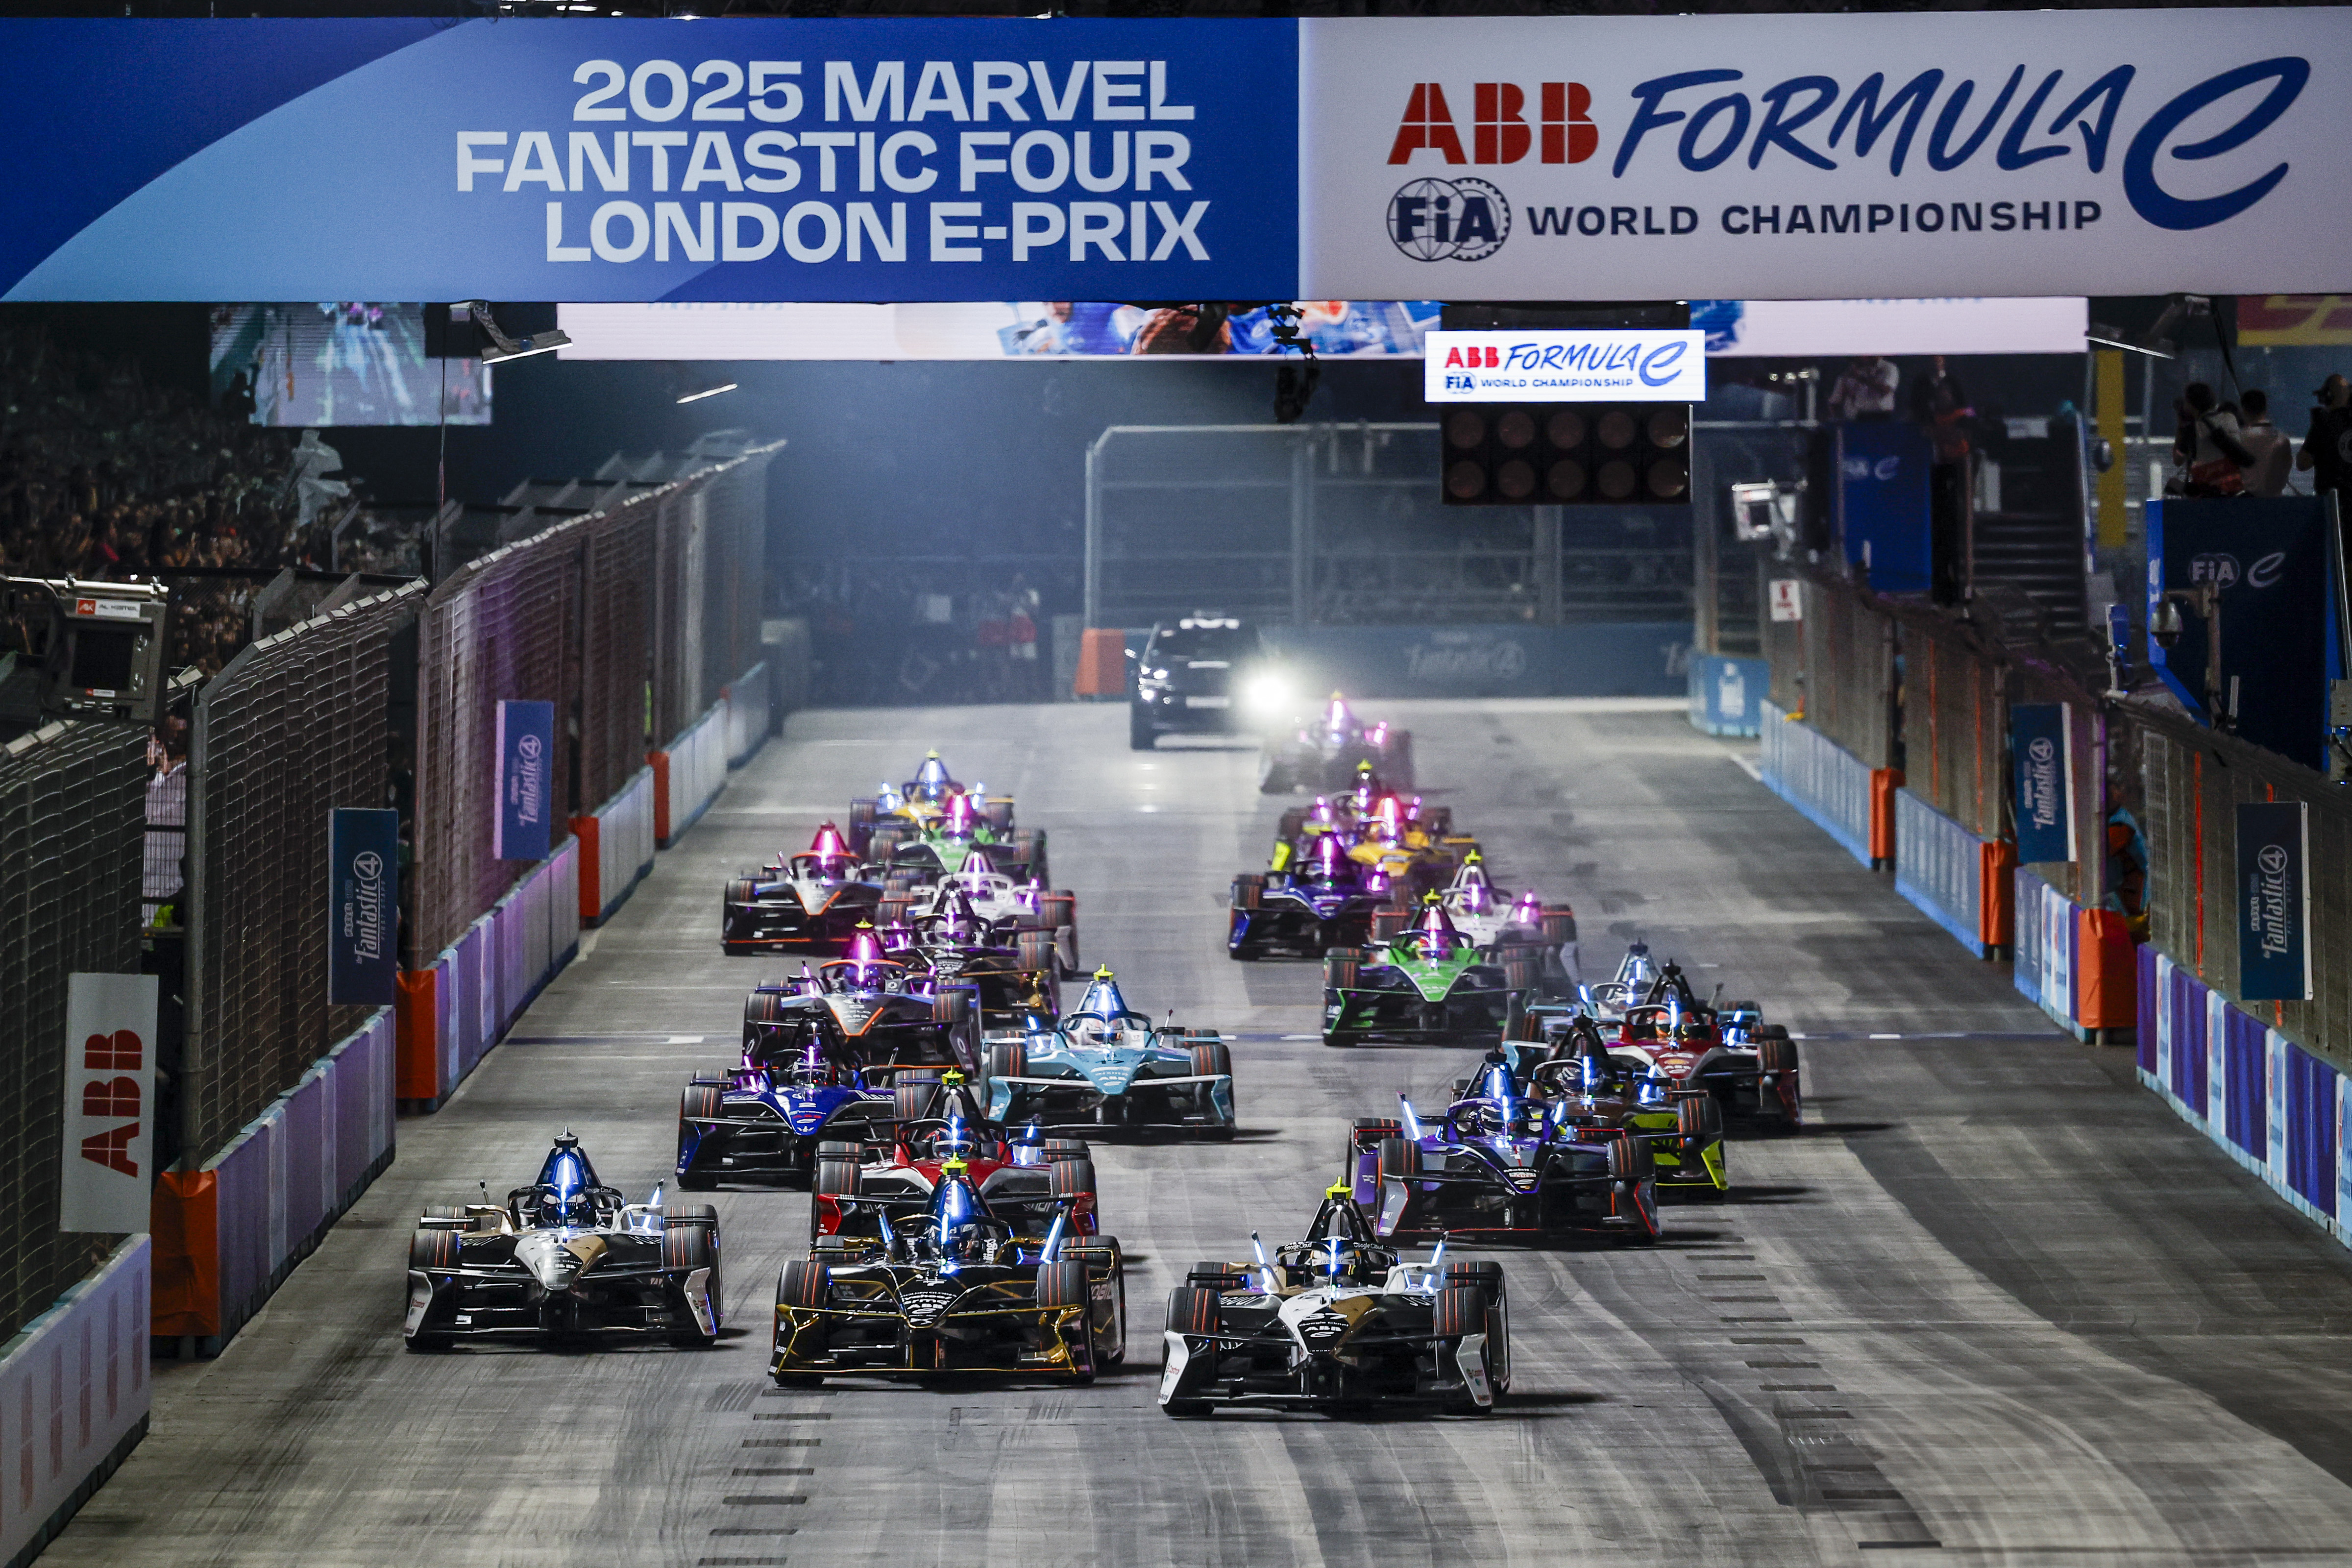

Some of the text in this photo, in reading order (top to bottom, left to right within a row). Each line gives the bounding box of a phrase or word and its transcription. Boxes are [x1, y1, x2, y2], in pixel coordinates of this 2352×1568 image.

[572, 59, 1196, 123] 2025 MARVEL
[1389, 82, 1598, 165] ABB
[1612, 63, 2137, 179] FORMULA
[456, 129, 1192, 194] FANTASTIC FOUR
[545, 200, 1211, 264] LONDON E-PRIX
[1526, 200, 2102, 236] WORLD CHAMPIONSHIP
[1446, 346, 1500, 368] ABB
[1504, 343, 1642, 372] FORMULA
[1481, 378, 1634, 388] WORLD CHAMPIONSHIP
[354, 880, 380, 959] Fantastic
[2260, 874, 2287, 953] Fantastic
[81, 1029, 143, 1178] ABB
